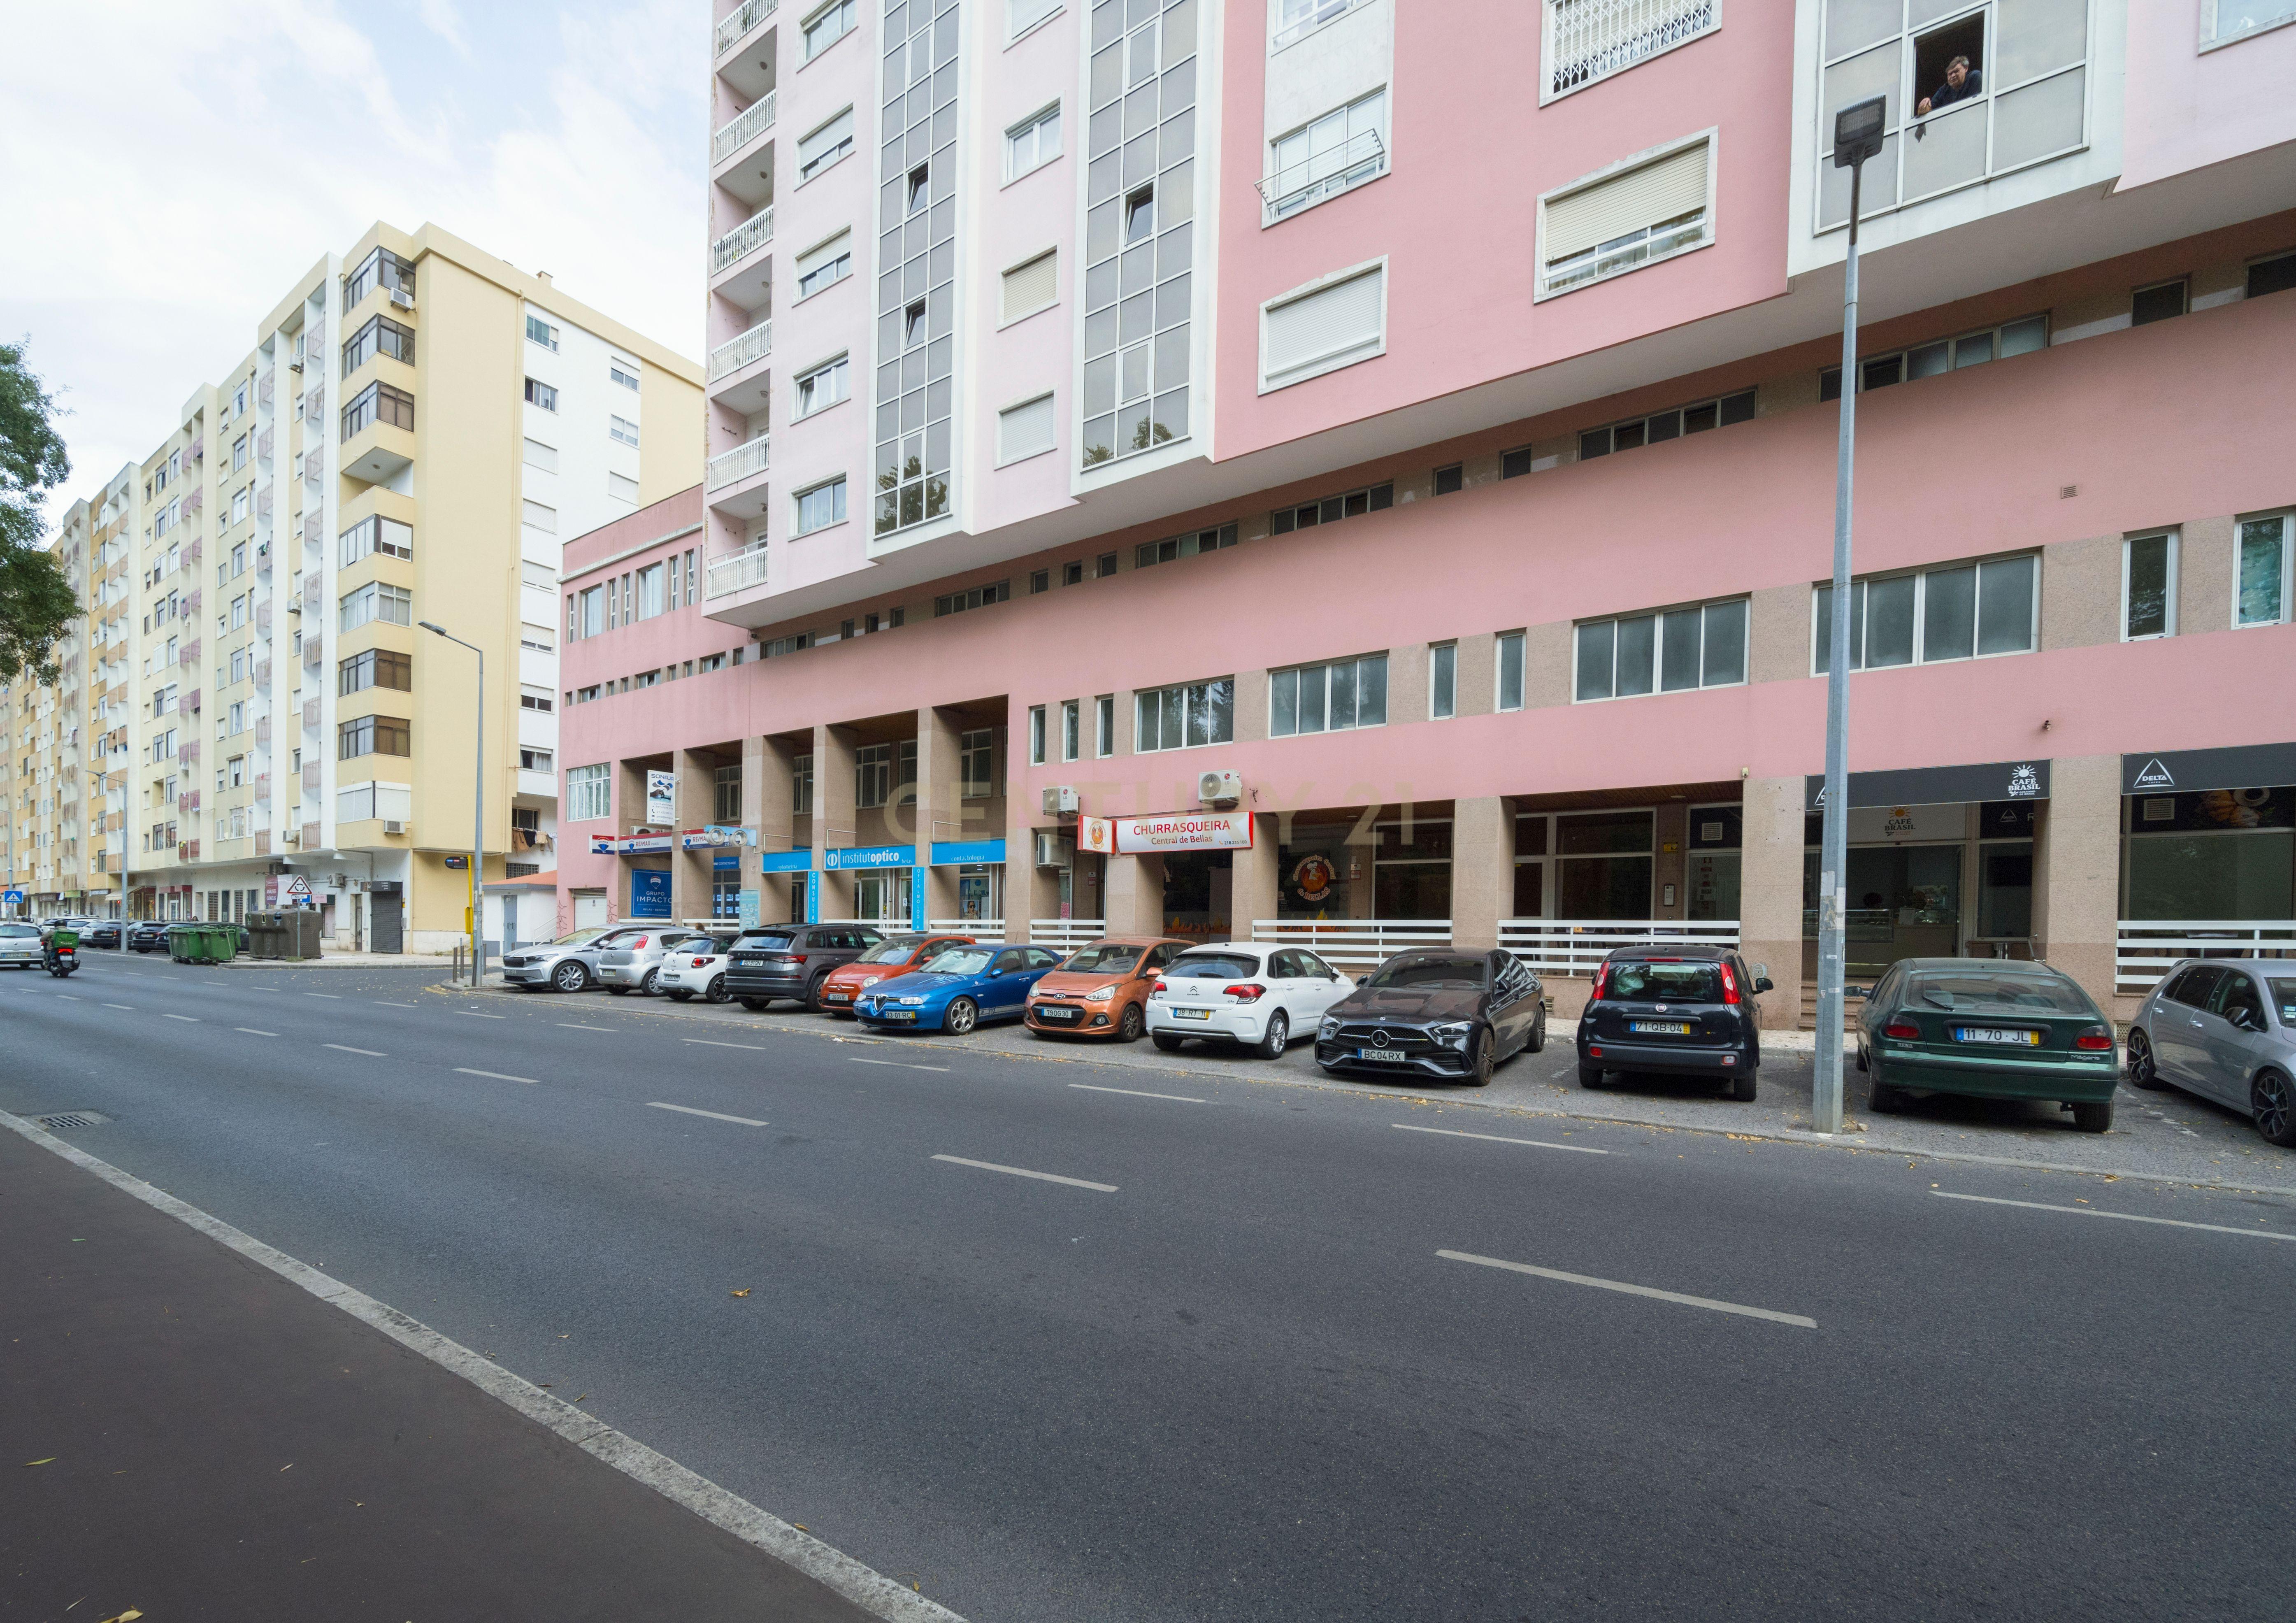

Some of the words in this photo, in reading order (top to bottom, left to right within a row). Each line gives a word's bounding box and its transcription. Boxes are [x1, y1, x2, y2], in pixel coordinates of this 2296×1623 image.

[1134, 820, 1230, 835] CHURRASQUEIRA
[1151, 837, 1178, 845] Central
[1190, 835, 1213, 843] Bellas
[843, 849, 899, 865] institutoptico
[1304, 887, 1330, 901] BELLAS
